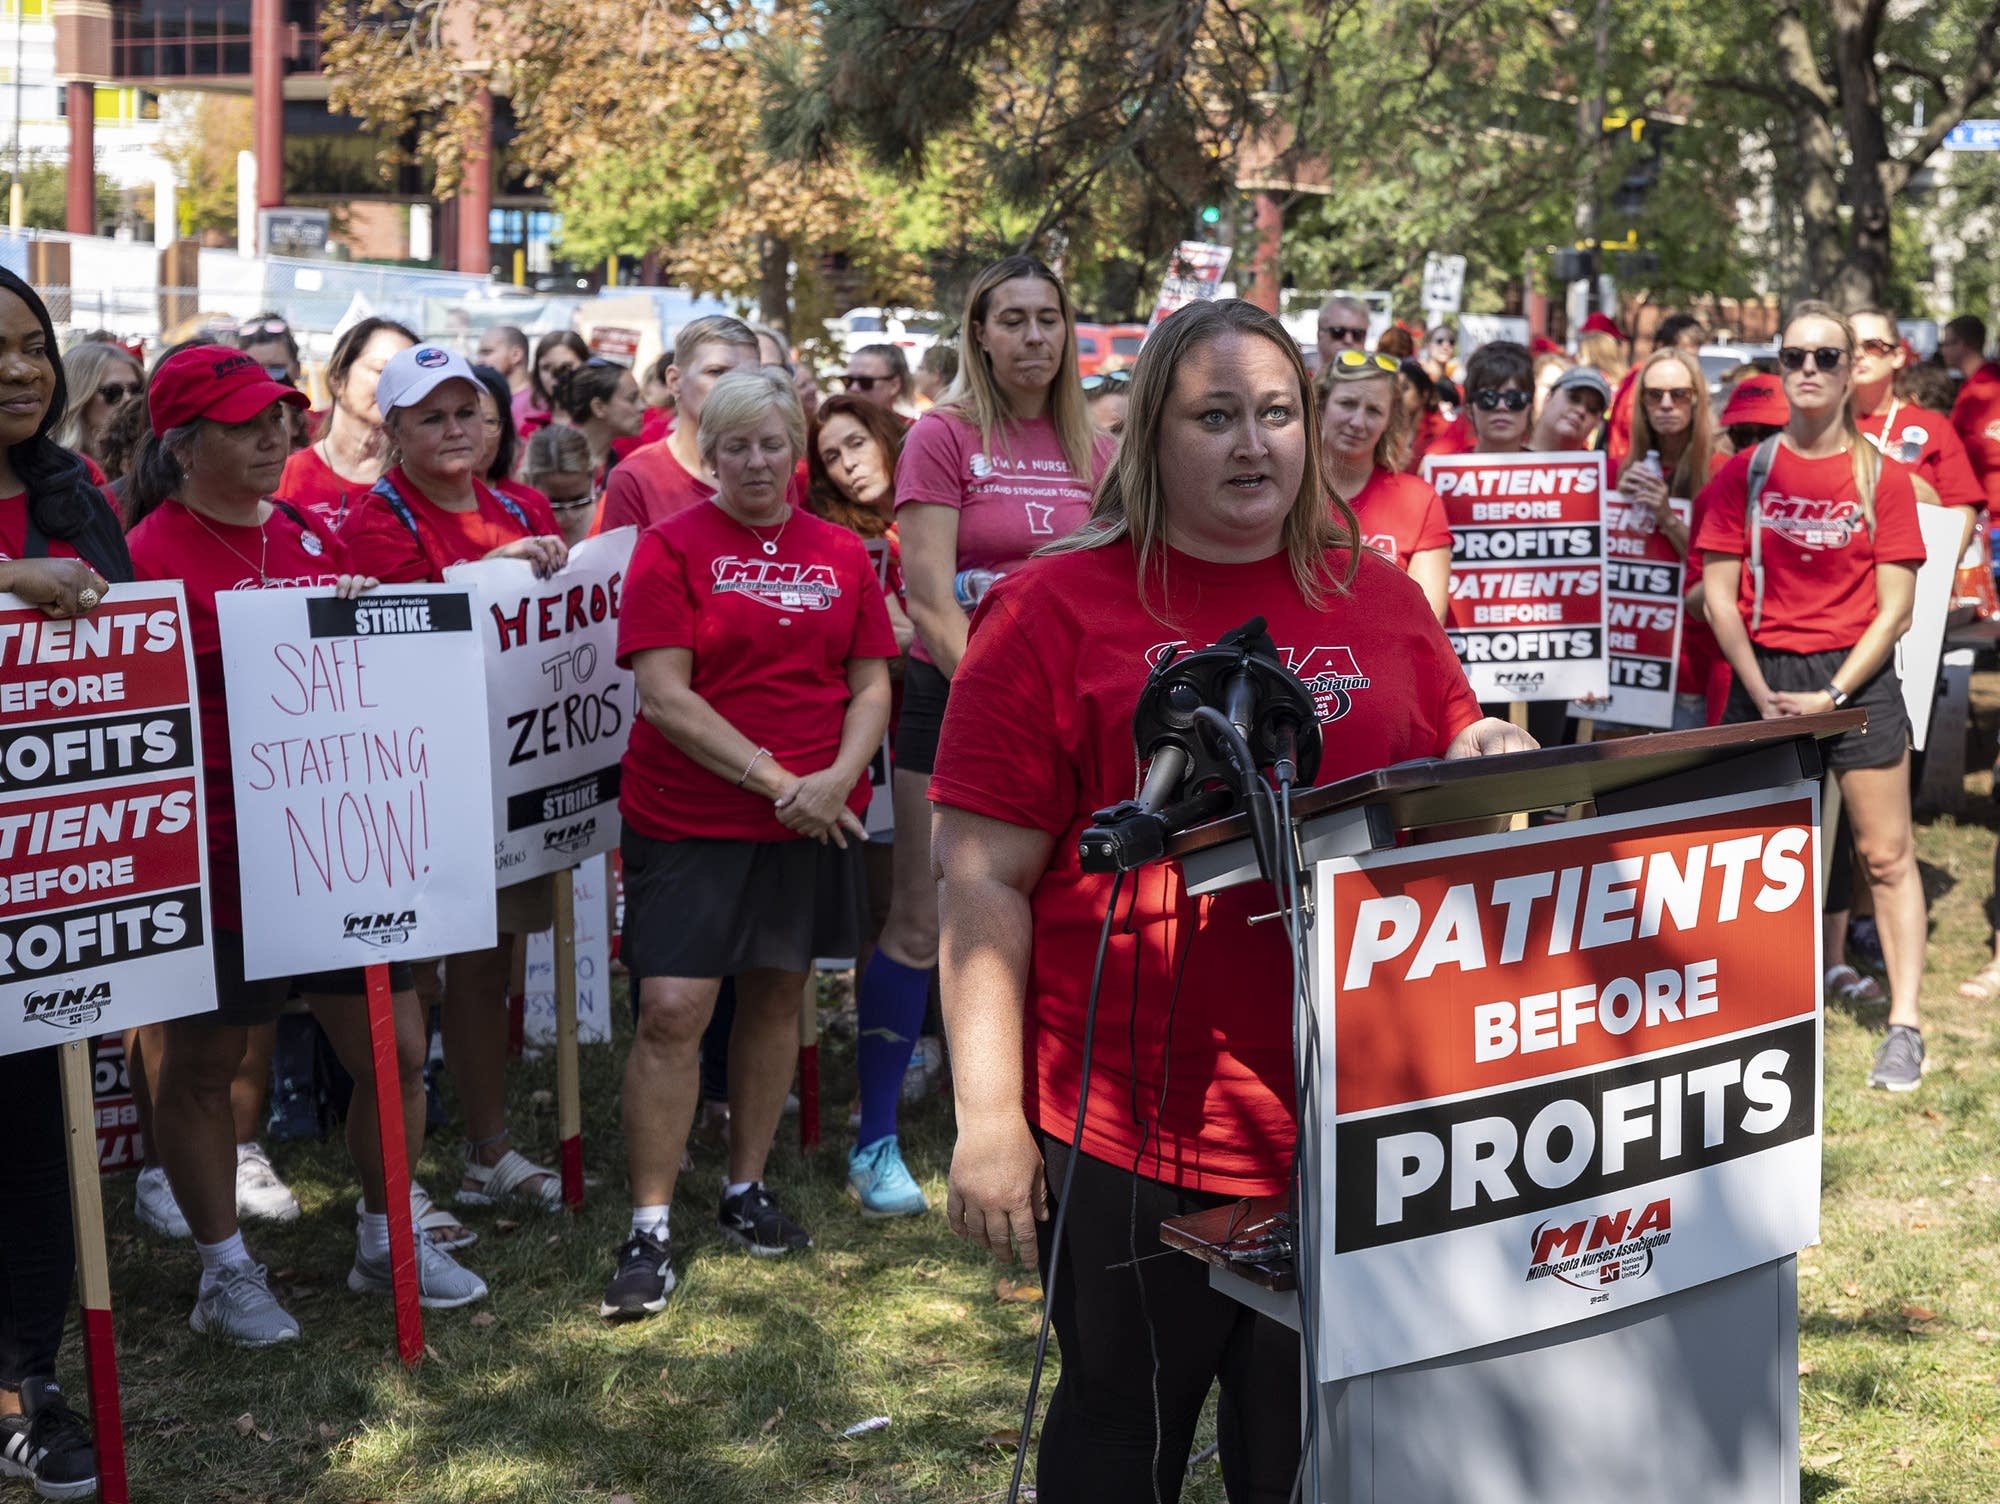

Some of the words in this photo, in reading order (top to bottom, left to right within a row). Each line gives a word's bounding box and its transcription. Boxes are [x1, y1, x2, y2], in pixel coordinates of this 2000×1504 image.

[1017, 461, 1026, 470] A
[1436, 467, 1598, 497] PATIENTS
[1472, 501, 1561, 520] BEFORE
[716, 562, 838, 589] MNA
[355, 606, 431, 634] STRIKE
[1474, 604, 1563, 624] BEFORE
[1453, 631, 1593, 661] PROFITS
[271, 637, 379, 716] SAFE
[541, 643, 597, 692] TO
[1, 672, 125, 712] EFORE
[507, 683, 621, 767] ZEROS
[0, 719, 177, 783] OFITS
[249, 726, 429, 791] STAFFING
[543, 783, 599, 820] STRIKE
[285, 780, 430, 896] NOW!
[345, 910, 417, 932] MNA
[1343, 827, 1810, 991] PATIENTS
[26, 982, 111, 1014] MNA
[1474, 959, 1718, 1063] BEFORE
[1376, 1049, 1791, 1227] PROFITS
[1531, 1198, 1671, 1265] MNA
[1526, 1257, 1582, 1281] Minnesota
[1580, 1249, 1618, 1268] Nurses
[1615, 1233, 1671, 1258] Association
[1621, 1263, 1640, 1272] Nurses
[1621, 1270, 1639, 1279] United
[1622, 1254, 1645, 1265] National
